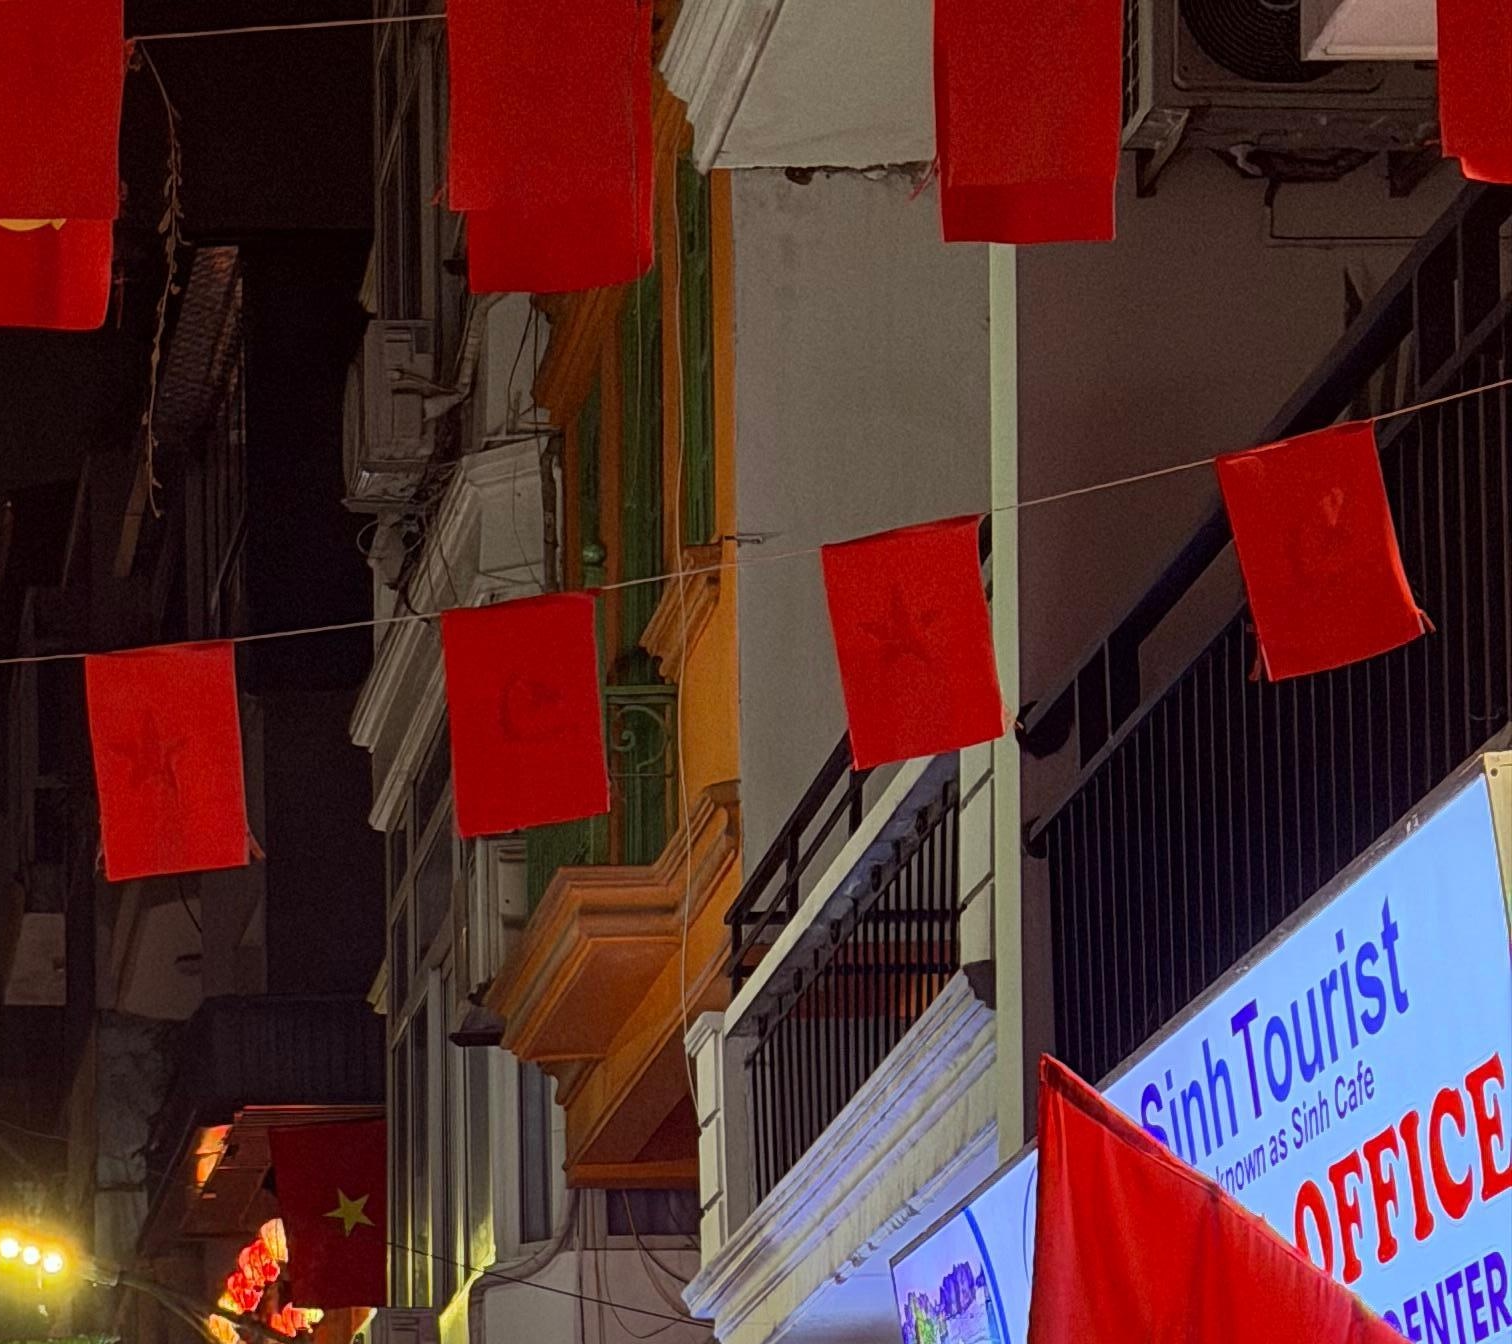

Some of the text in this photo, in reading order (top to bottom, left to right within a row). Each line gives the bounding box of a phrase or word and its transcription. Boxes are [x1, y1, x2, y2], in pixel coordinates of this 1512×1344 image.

[1269, 1128, 1288, 1166] as
[1292, 1091, 1330, 1149] Sinh
[1335, 1060, 1374, 1119] Cafe
[1294, 1052, 1512, 1285] OFFICE
